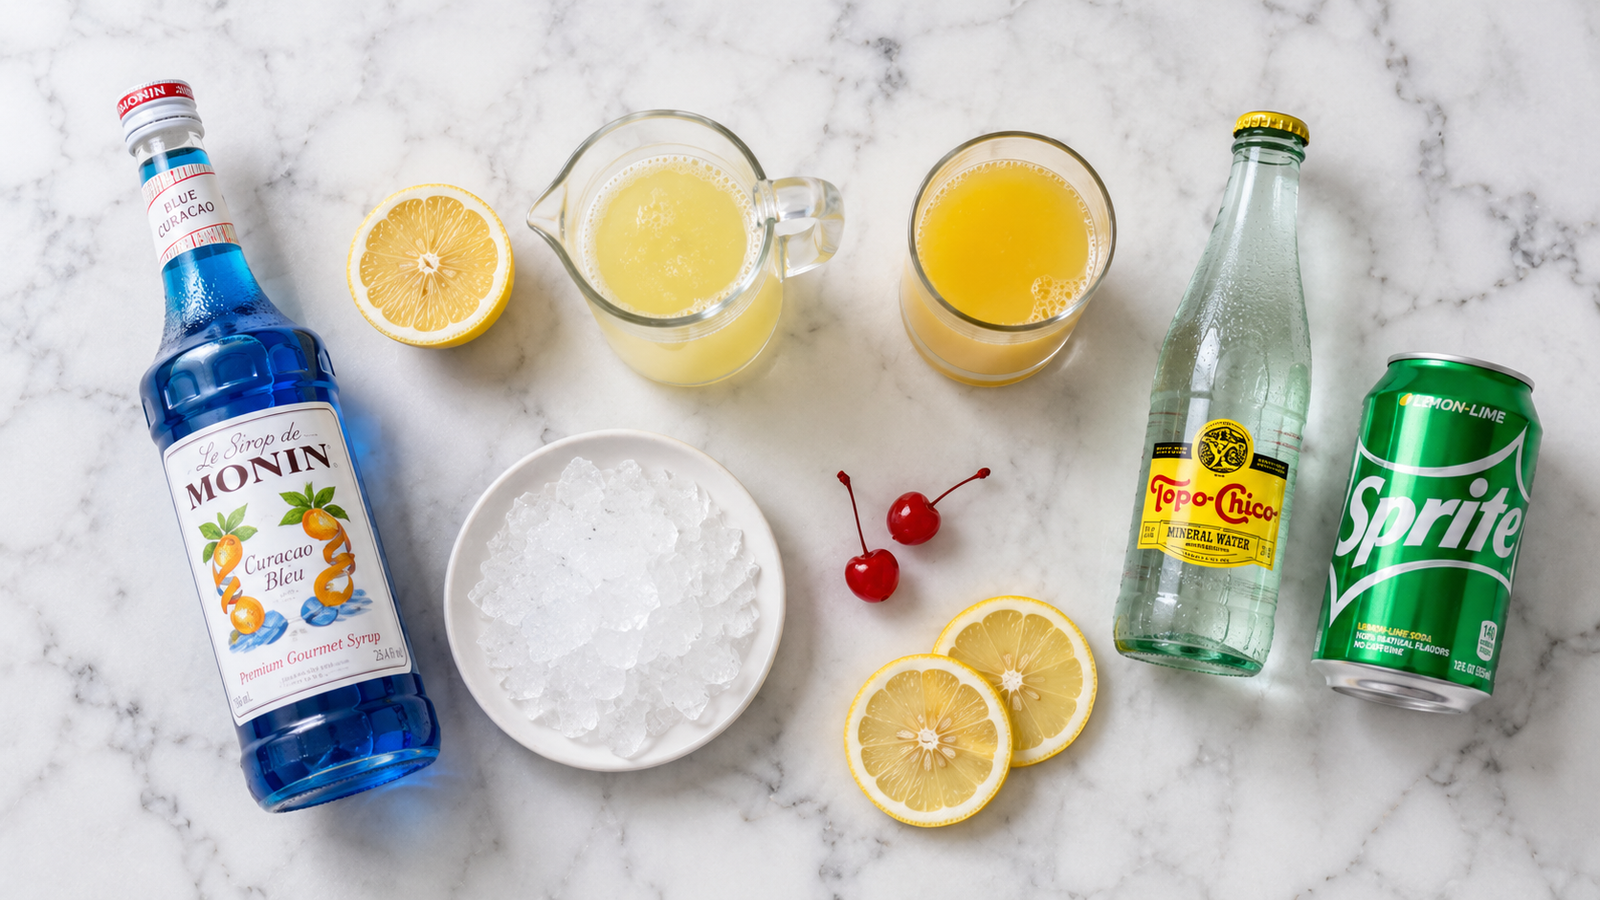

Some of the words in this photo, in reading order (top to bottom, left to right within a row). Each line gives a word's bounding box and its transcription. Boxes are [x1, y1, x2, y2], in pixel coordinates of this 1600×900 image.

[163, 189, 198, 214] BLUE
[157, 201, 215, 239] CURACAO
[1412, 394, 1506, 424] LEMON-LIME
[196, 441, 219, 472] Le
[223, 432, 275, 456] Sirop
[280, 421, 302, 443] de
[185, 443, 331, 511] MONIN
[1166, 526, 1213, 543] MINERAL
[1216, 532, 1250, 551] WATER
[1335, 475, 1523, 569] Sprite
[244, 543, 314, 576] Curacao
[264, 569, 306, 592] Bleu
[239, 659, 284, 686] Premium
[286, 638, 343, 666] Gourmet
[346, 633, 381, 650] Syrup
